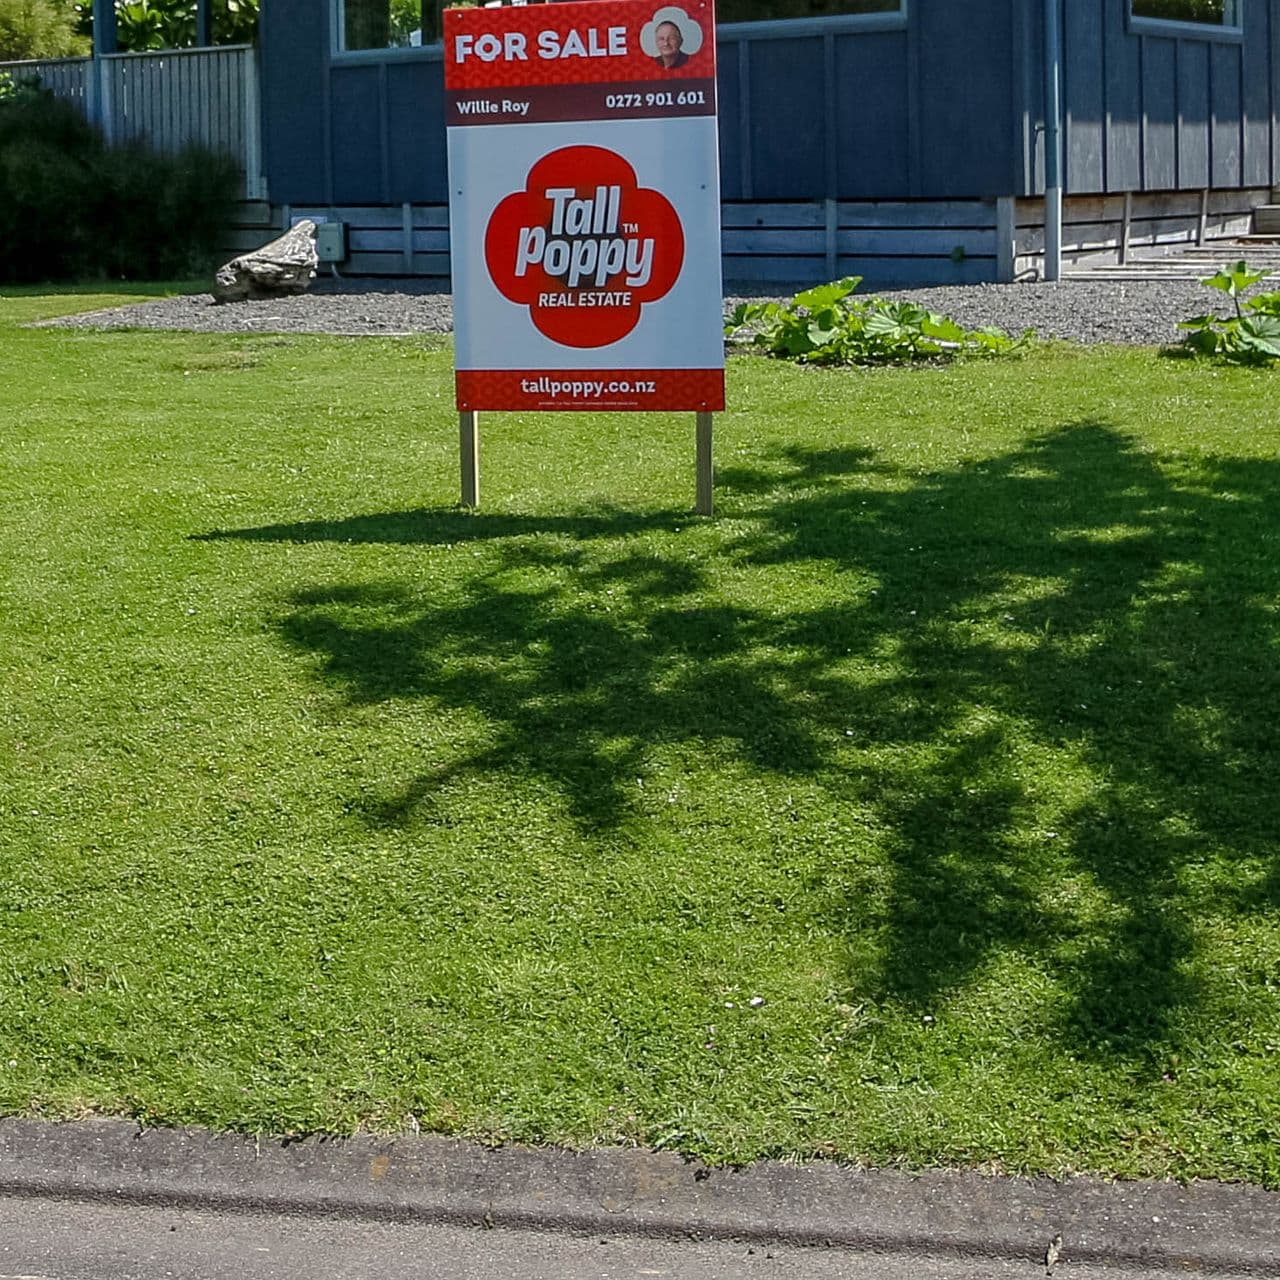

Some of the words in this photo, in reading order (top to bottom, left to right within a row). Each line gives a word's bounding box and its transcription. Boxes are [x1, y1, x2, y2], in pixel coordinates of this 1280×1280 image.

[455, 32, 528, 64] FOR
[537, 27, 628, 60] SALE
[456, 101, 499, 114] Willie
[502, 100, 530, 116] Roy
[606, 94, 642, 108] 0272
[646, 93, 673, 107] 901
[677, 91, 705, 106] 601
[545, 186, 621, 235] Tall
[538, 293, 575, 308] REAL
[578, 292, 632, 307] ESTATE
[521, 377, 656, 397] tallpoppy.co.nz
